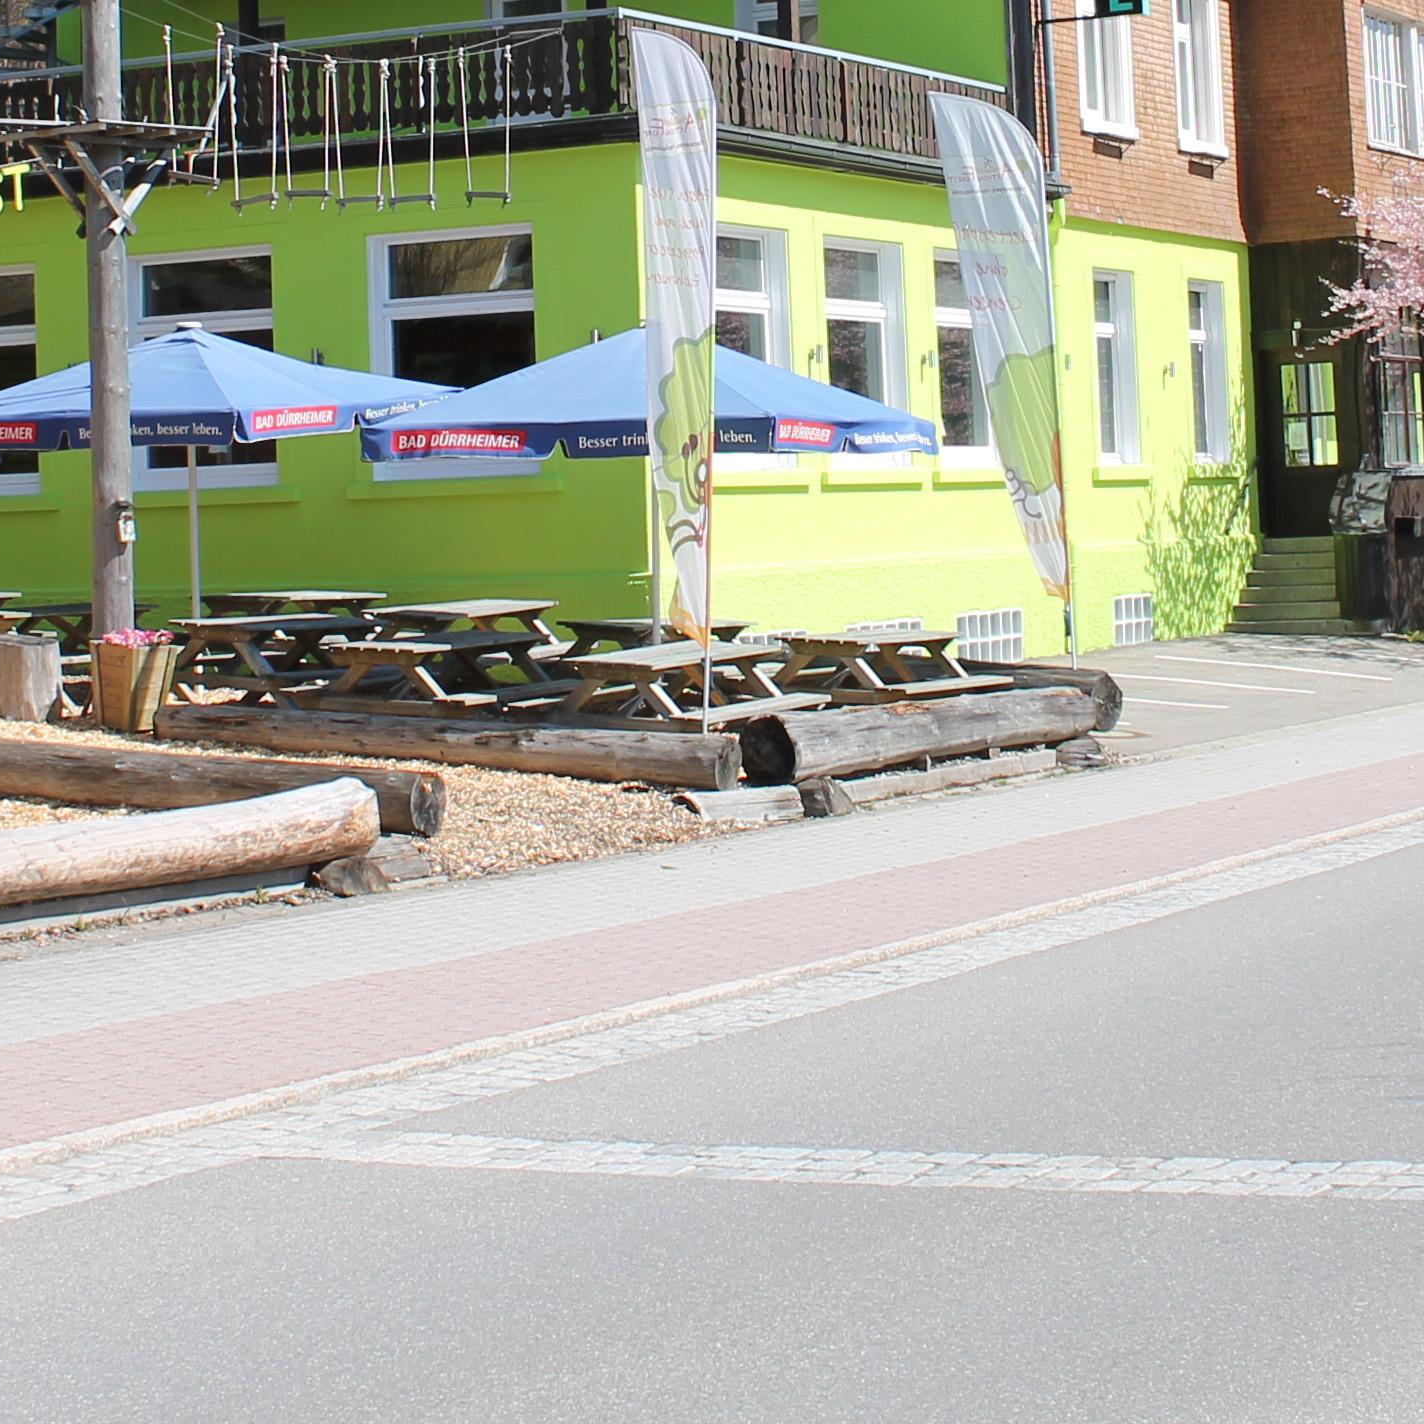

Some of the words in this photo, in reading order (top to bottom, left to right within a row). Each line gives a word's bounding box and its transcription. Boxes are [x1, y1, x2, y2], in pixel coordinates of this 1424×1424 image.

[156, 421, 190, 436] besser
[192, 421, 223, 436] leben.
[255, 415, 274, 430] BAD
[276, 409, 334, 426] DÜRRHEIMER
[398, 433, 427, 450] BAD
[430, 430, 521, 449] DÜRRHEIMER
[578, 435, 619, 449] Besser
[719, 429, 757, 444] leben.
